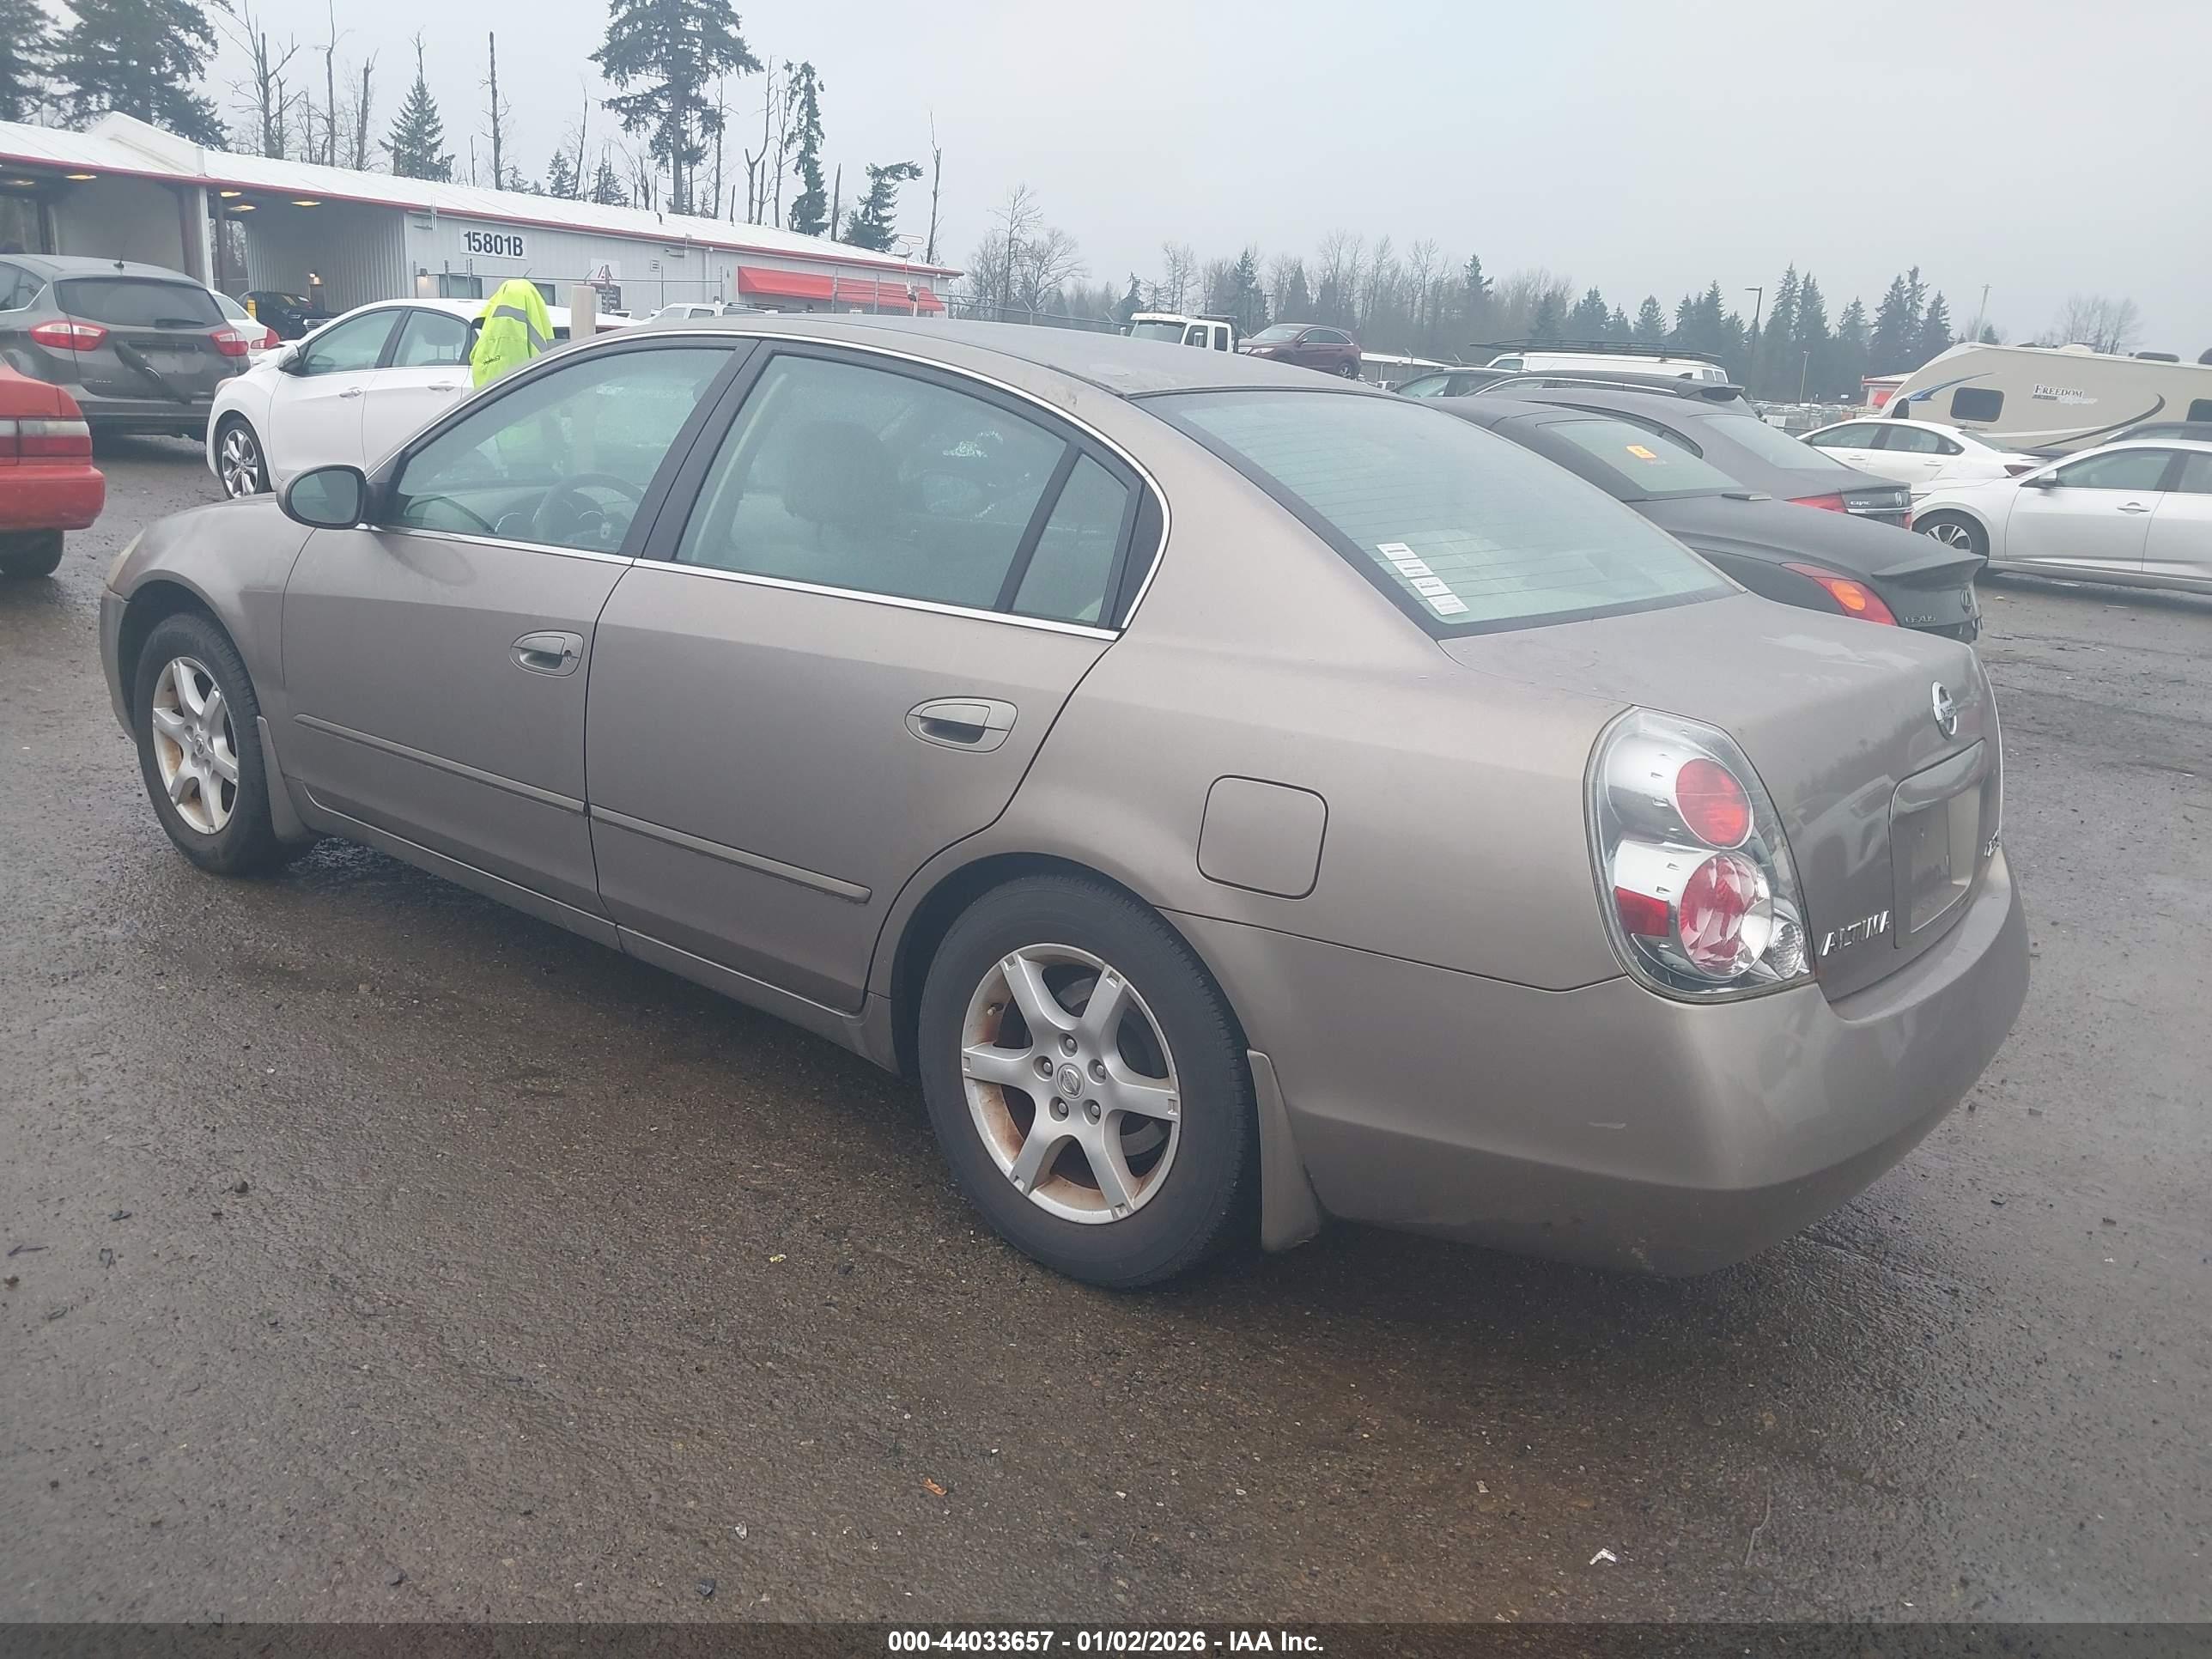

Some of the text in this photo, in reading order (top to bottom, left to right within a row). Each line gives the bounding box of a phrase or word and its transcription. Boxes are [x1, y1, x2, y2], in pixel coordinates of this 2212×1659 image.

[464, 230, 523, 257] 15801B
[2034, 384, 2083, 398] FREEDOM
[1820, 910, 1890, 956] ALTIMA
